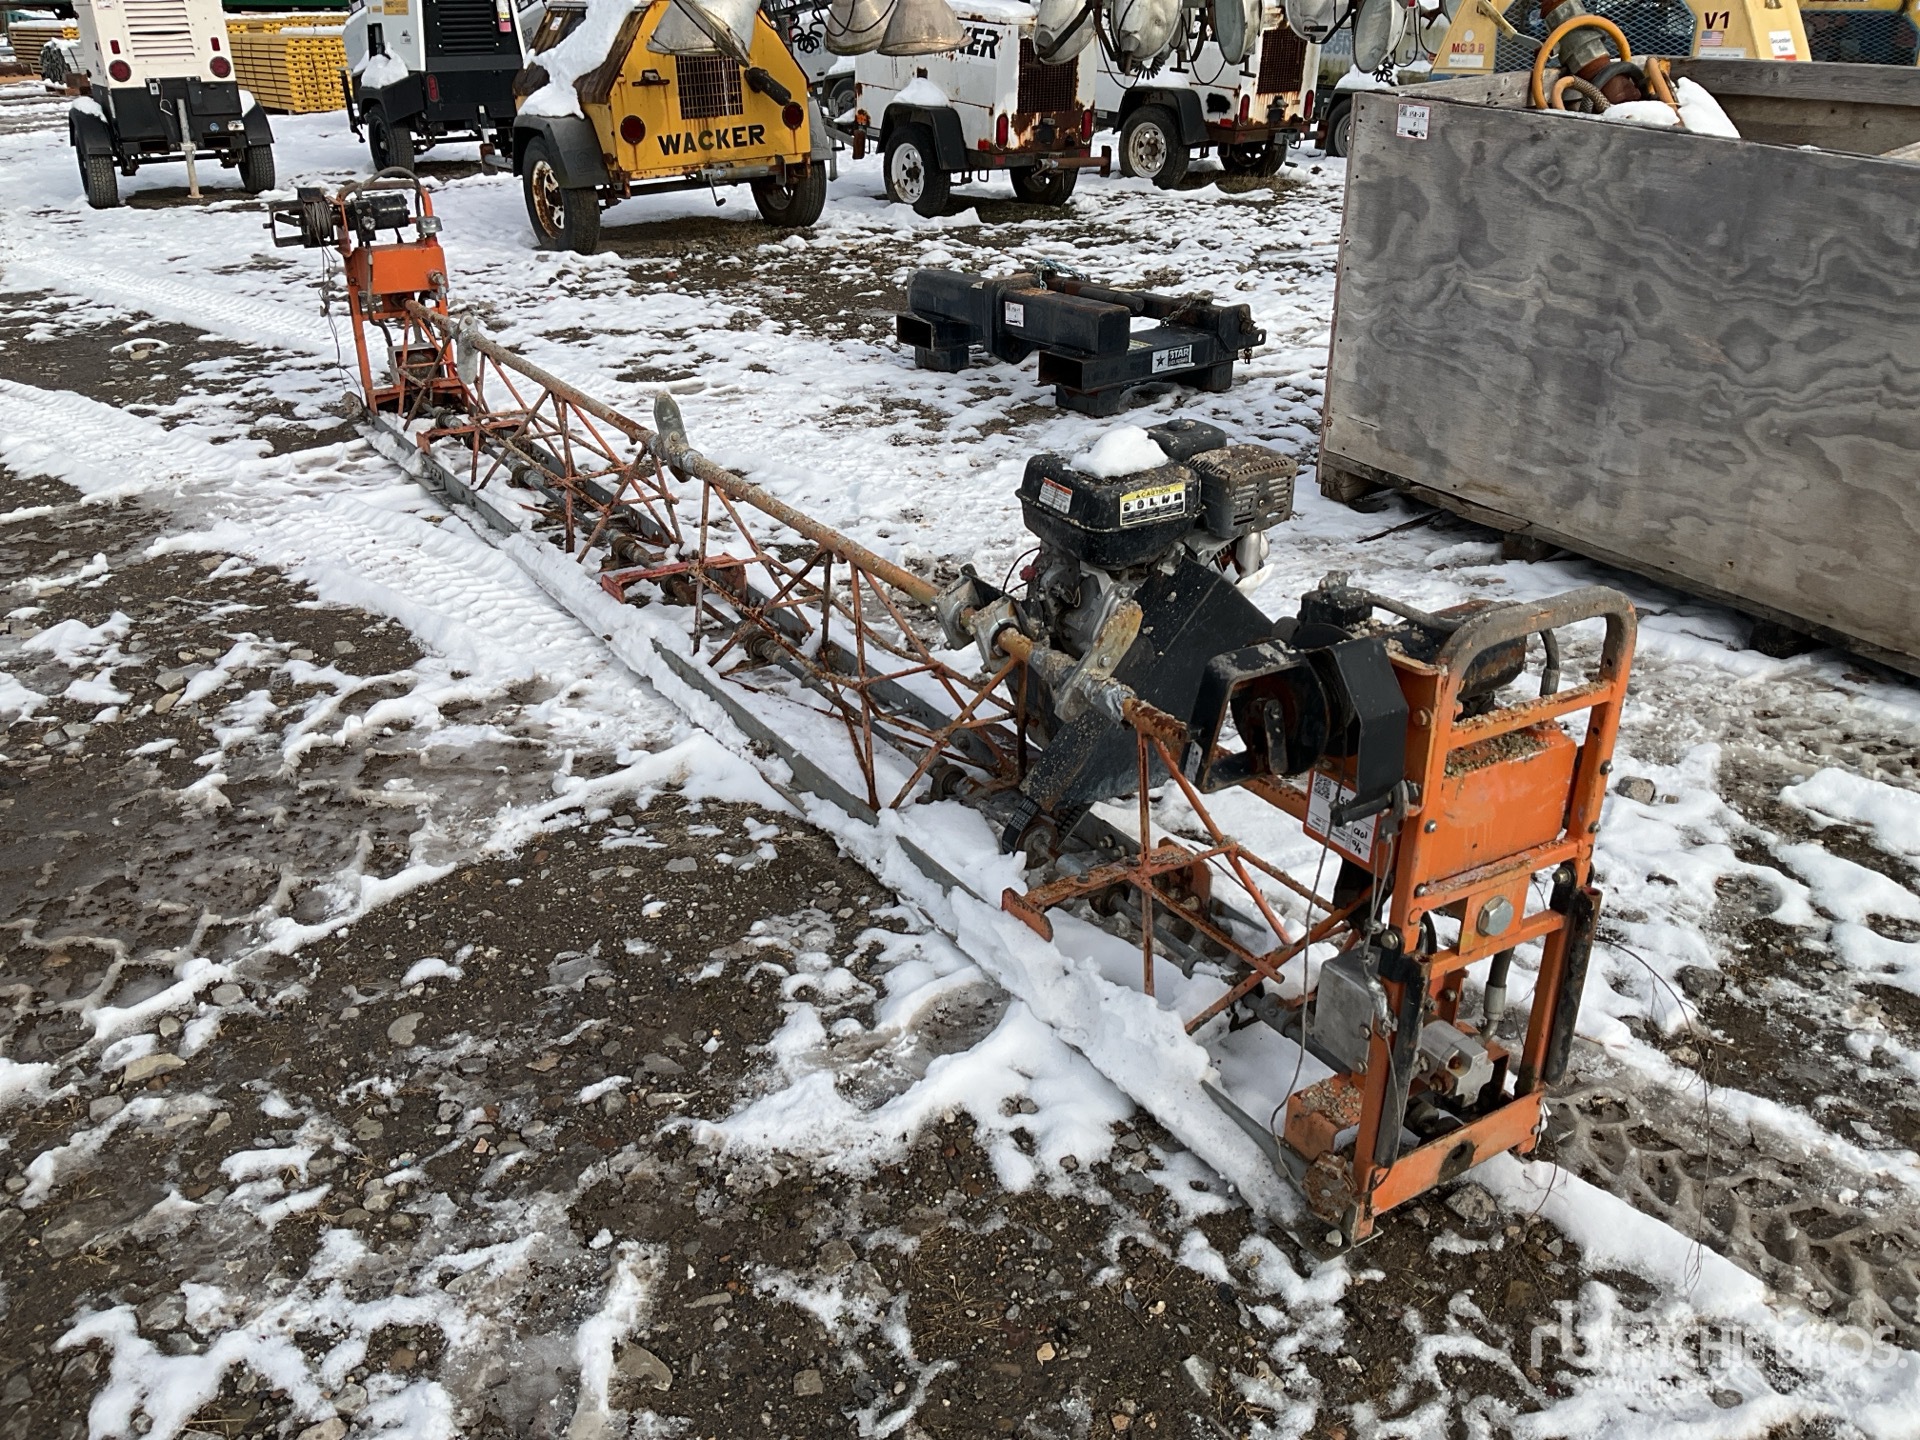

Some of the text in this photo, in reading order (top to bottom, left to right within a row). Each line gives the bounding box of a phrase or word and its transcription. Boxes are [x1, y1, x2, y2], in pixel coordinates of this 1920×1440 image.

[1704, 11, 1730, 30] V1
[1451, 43, 1467, 53] MC
[657, 124, 766, 156] WACKER
[1169, 348, 1190, 360] STAR
[1141, 487, 1171, 498] CAUTION
